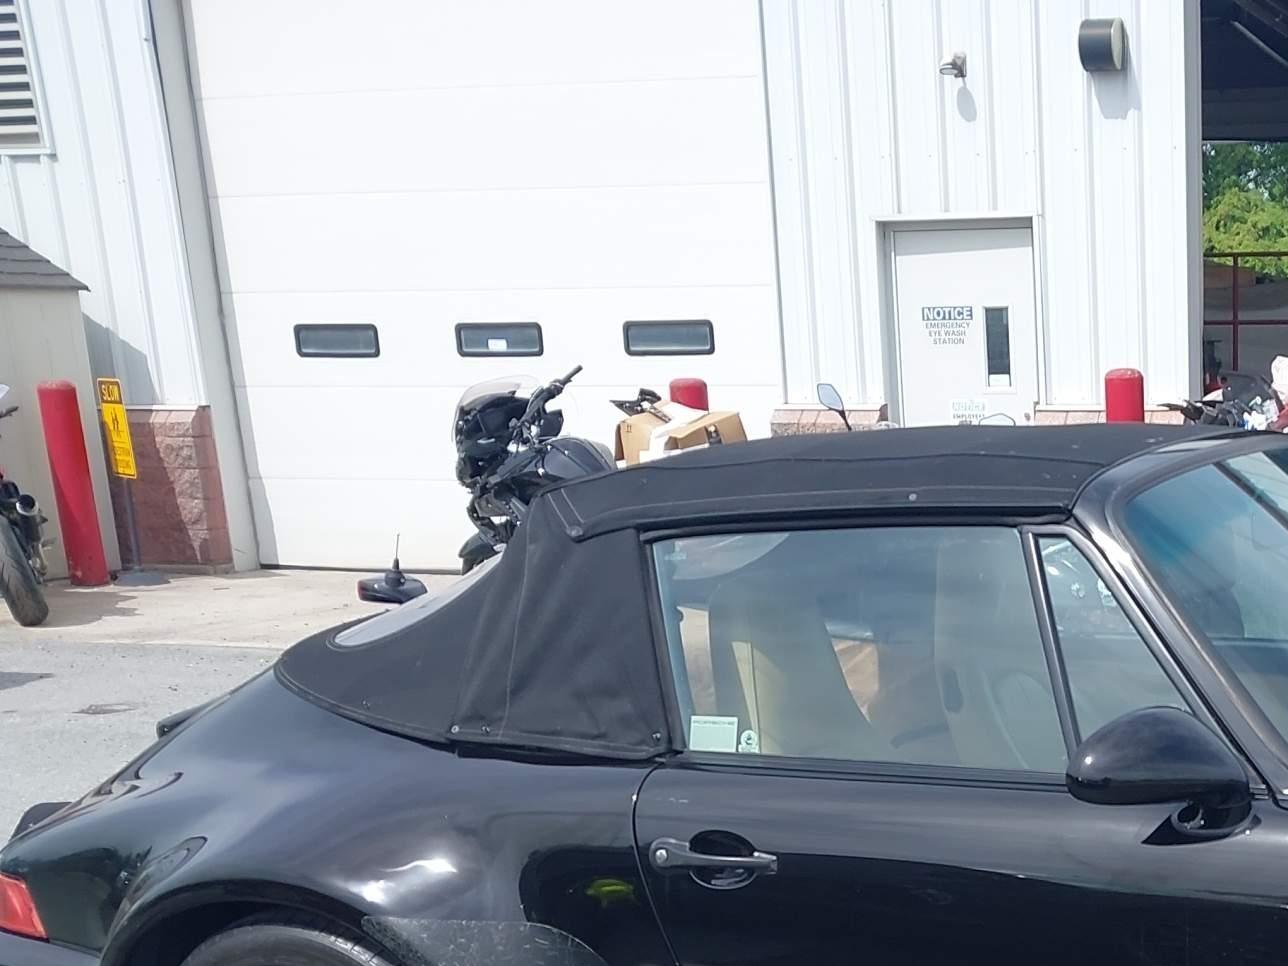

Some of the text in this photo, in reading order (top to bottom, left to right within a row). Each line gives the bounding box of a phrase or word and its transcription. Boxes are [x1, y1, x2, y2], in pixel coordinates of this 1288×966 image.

[924, 307, 973, 320] NOTICE
[925, 321, 970, 329] EMERGENCY
[928, 329, 966, 338] EYE WASH
[933, 337, 965, 345] STATION
[101, 384, 120, 401] SLOW
